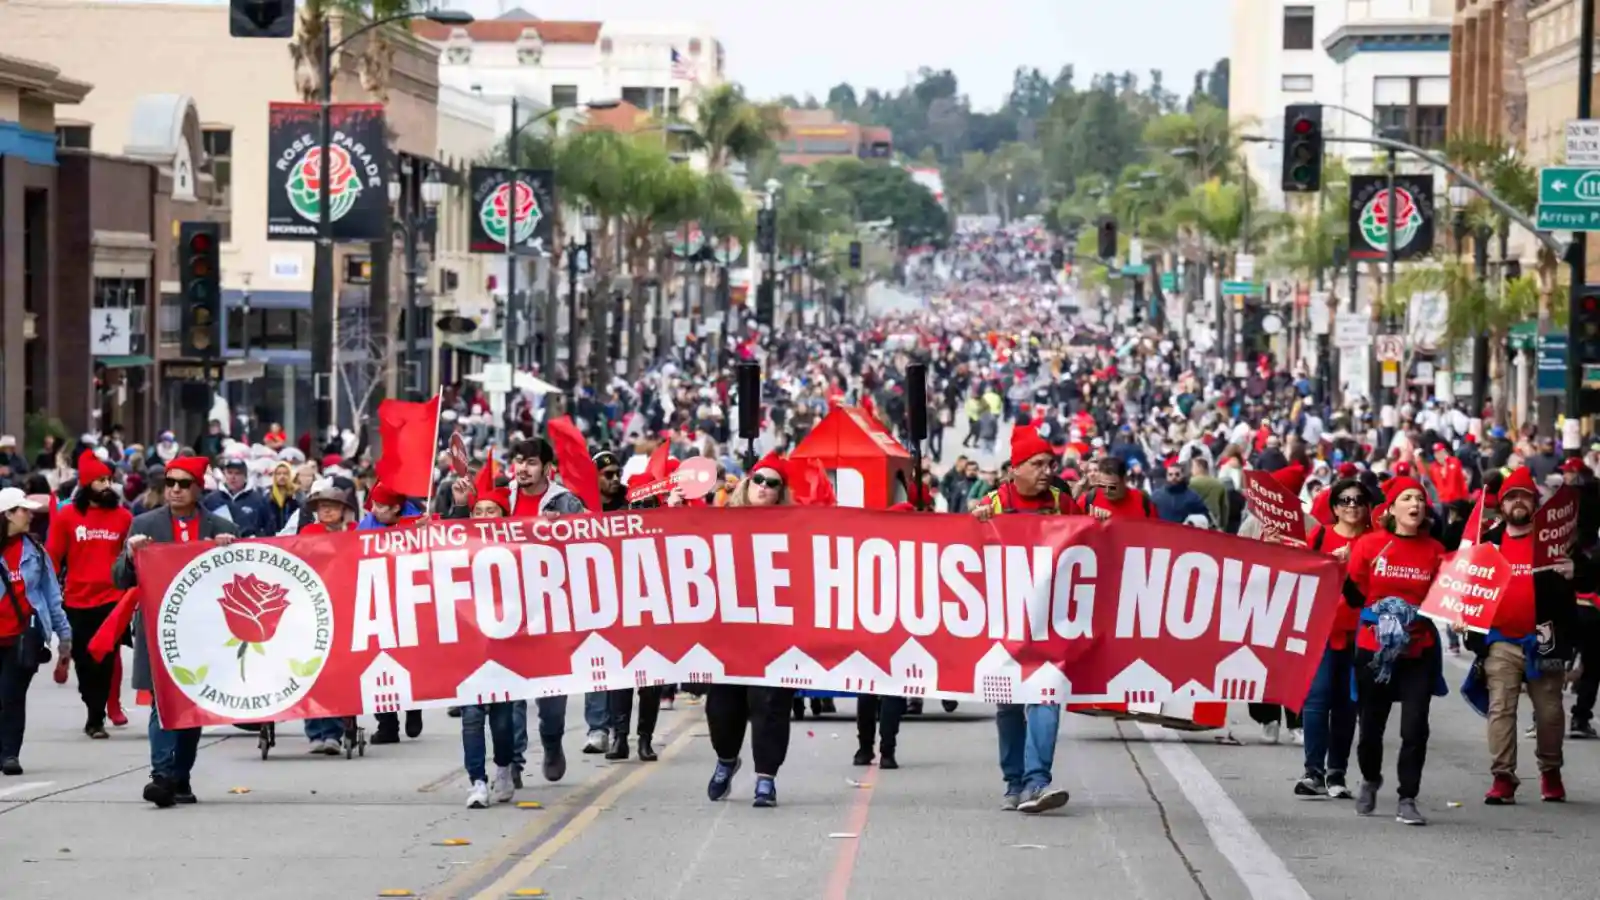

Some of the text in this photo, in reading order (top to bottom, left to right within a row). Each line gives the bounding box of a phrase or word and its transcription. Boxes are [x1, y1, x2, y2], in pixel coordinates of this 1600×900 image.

[276, 130, 381, 188] ROSE PARADE
[1567, 140, 1599, 152] BLOCK
[268, 224, 318, 235] HONDA
[1541, 211, 1586, 224] Arroyo
[1249, 477, 1284, 504] Rent
[1247, 488, 1299, 522] Control
[359, 514, 663, 555] TURNING THE CORNER...
[1455, 558, 1495, 580] Rent
[350, 533, 1320, 656] AFFORDABLE HOUSING NOW!
[1438, 574, 1500, 601] Control
[163, 549, 330, 663] THE PEOPLE'S ROSE PARADE MARCH
[1439, 595, 1484, 617] Now!
[199, 677, 300, 709] JANUARY 2nd
